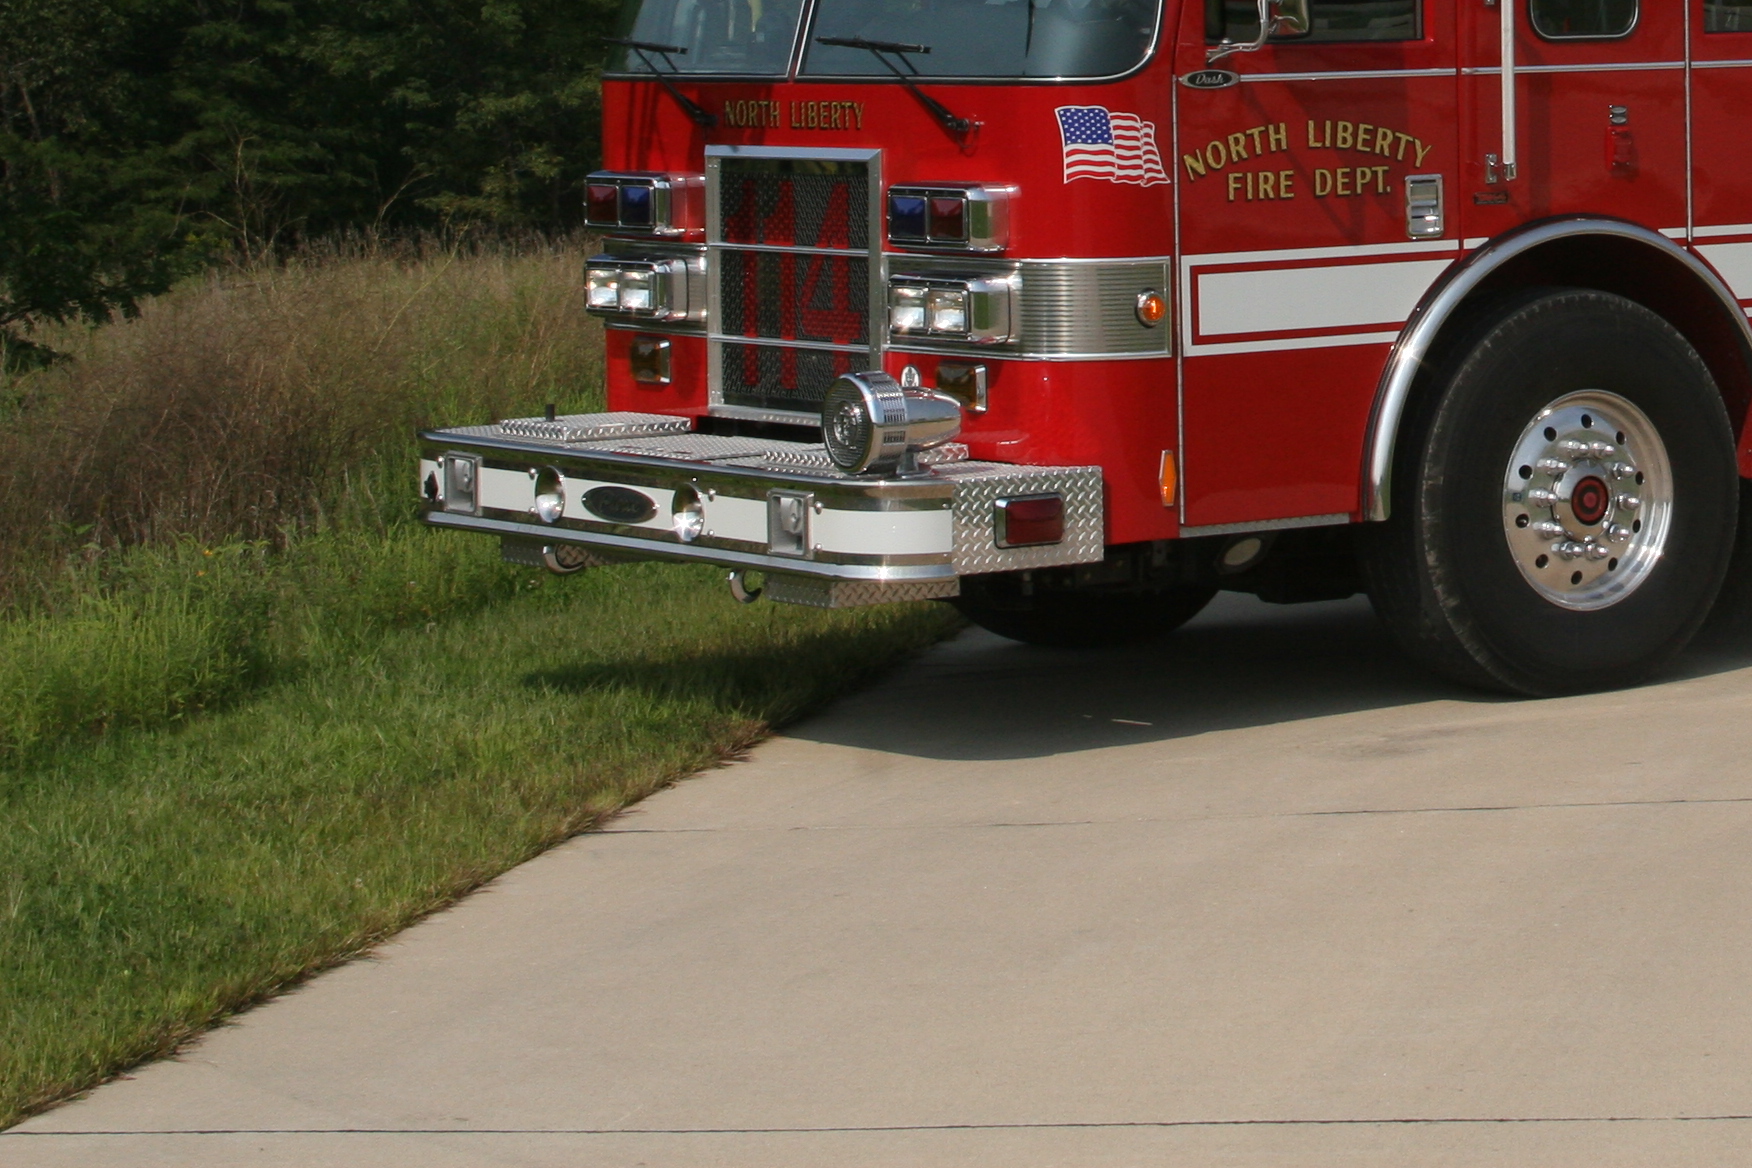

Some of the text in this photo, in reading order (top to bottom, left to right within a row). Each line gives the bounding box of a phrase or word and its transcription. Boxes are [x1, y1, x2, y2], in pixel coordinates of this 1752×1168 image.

[1195, 73, 1224, 84] Dash
[724, 100, 865, 130] NORTH LIBERTY
[1183, 119, 1432, 181] NORTH LIBERTY
[1227, 165, 1391, 201] FIRE DEPT.
[726, 180, 862, 390] 114
